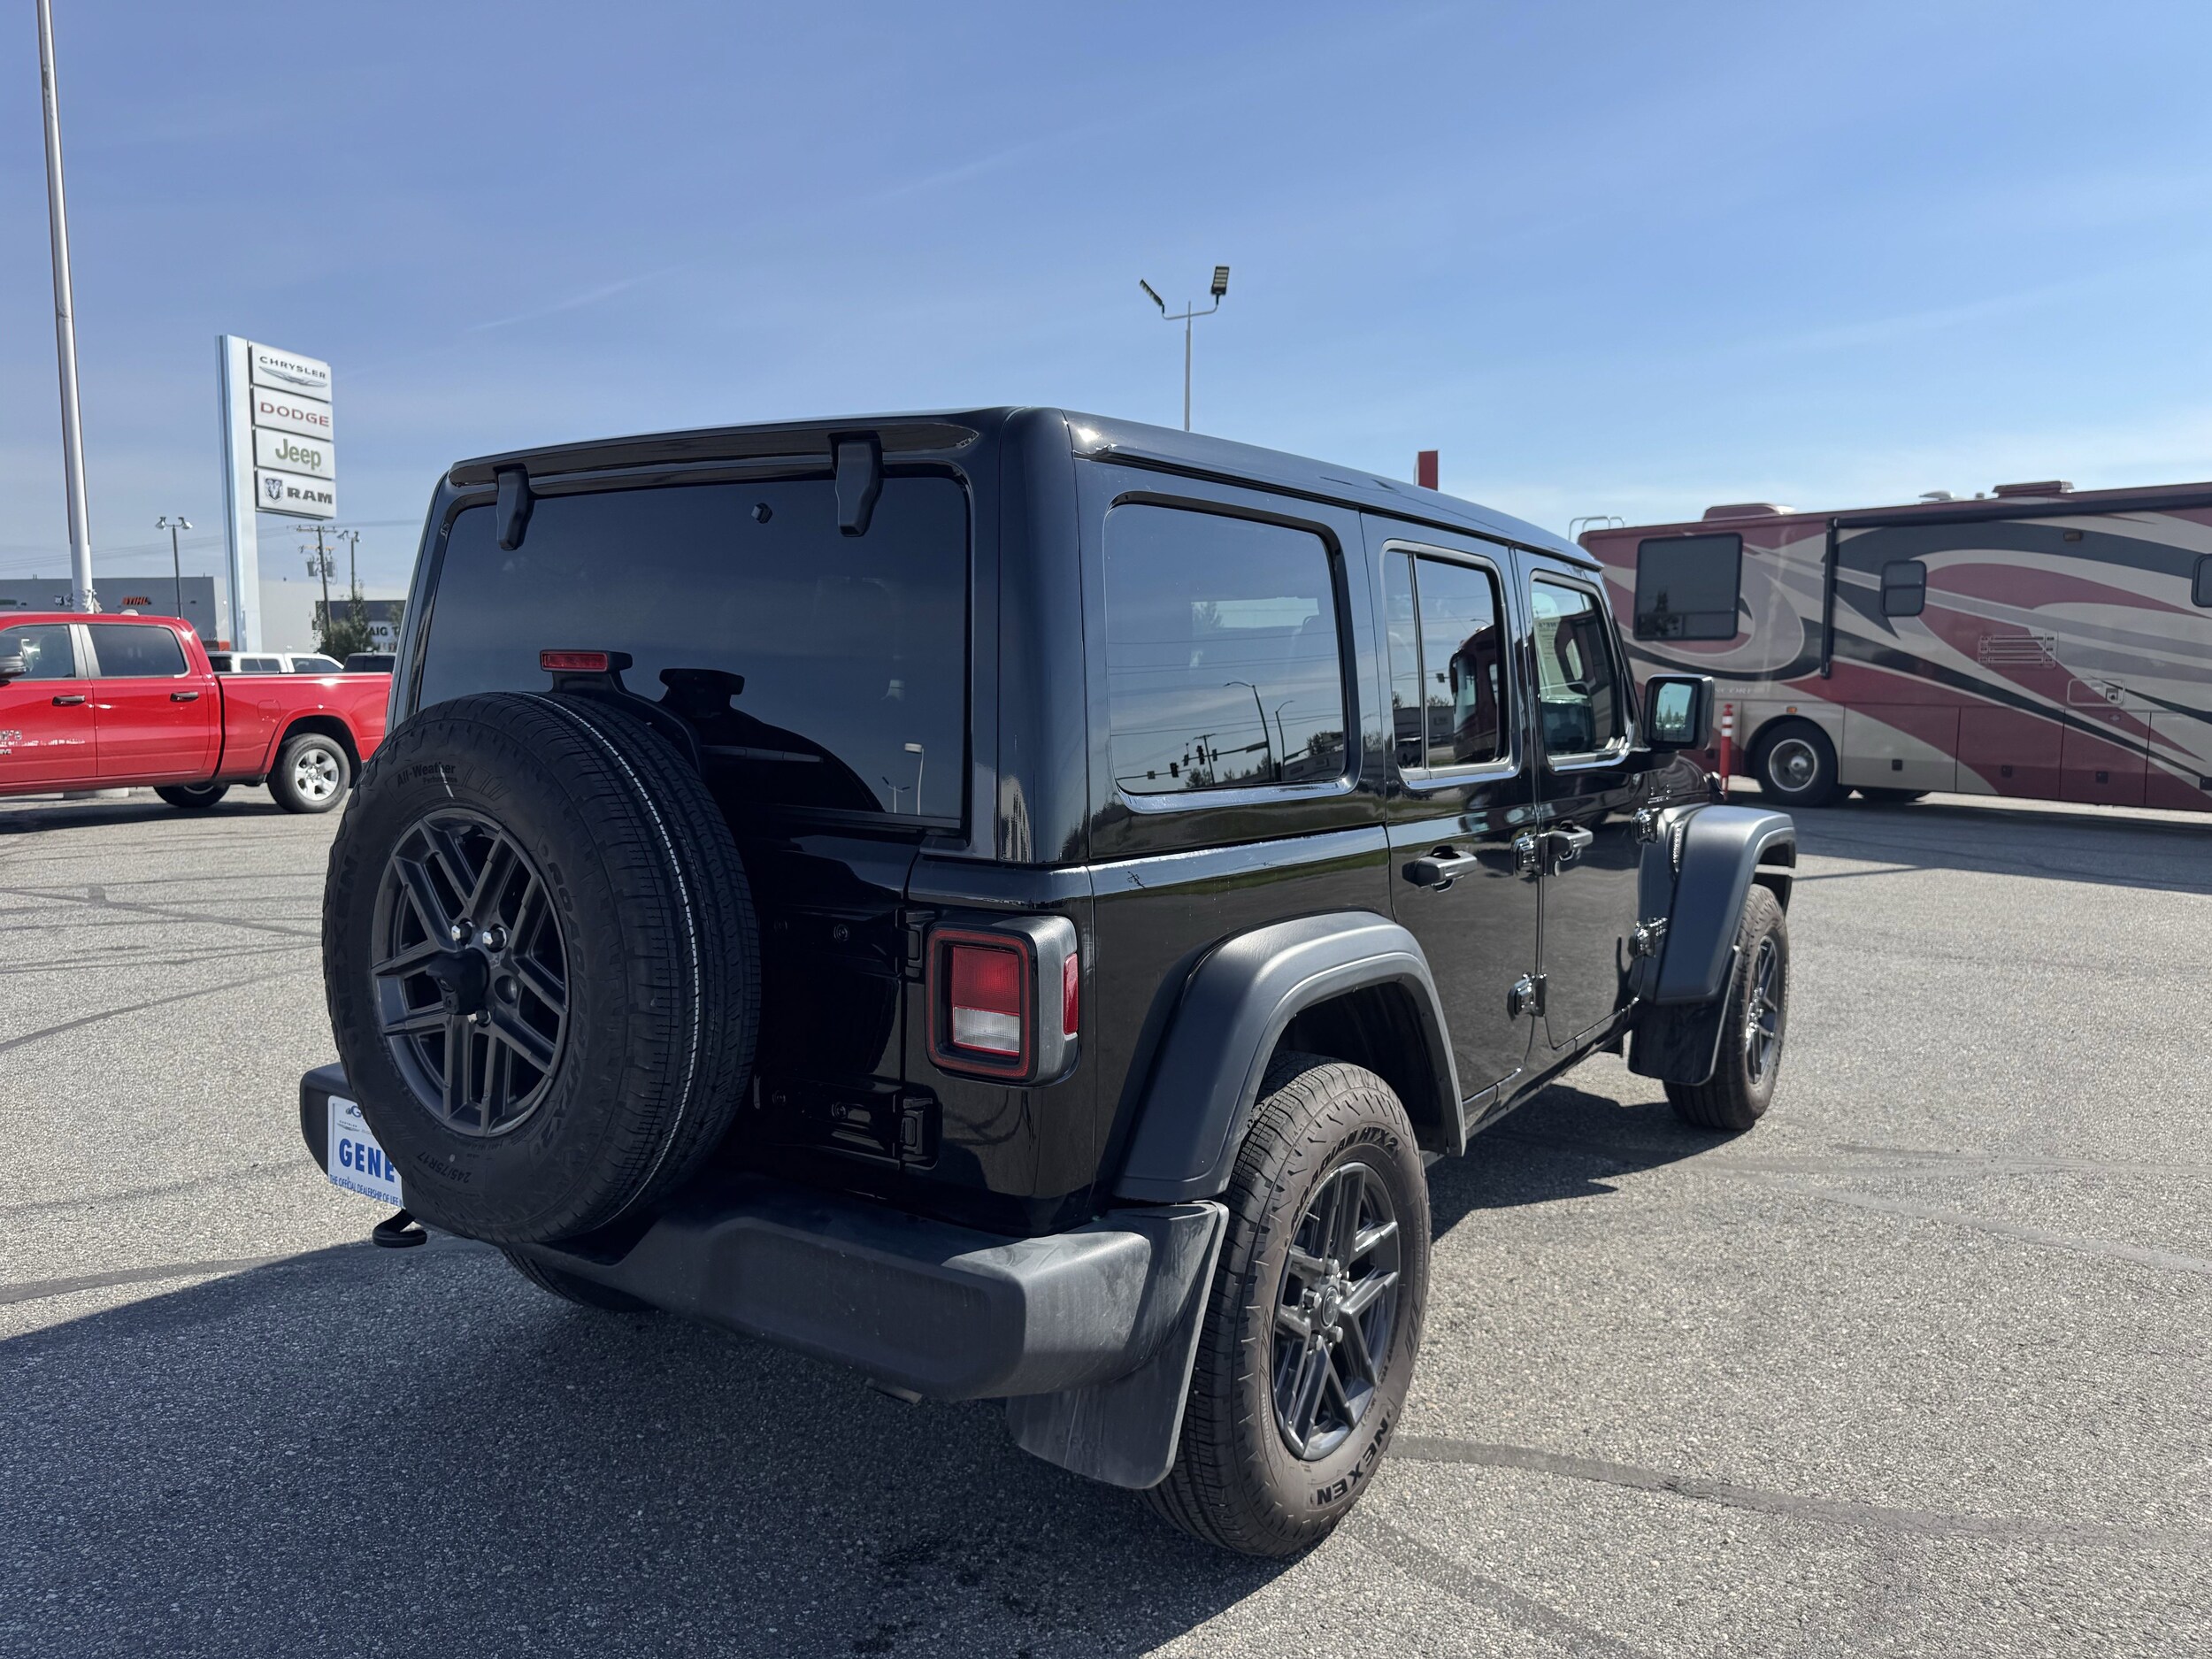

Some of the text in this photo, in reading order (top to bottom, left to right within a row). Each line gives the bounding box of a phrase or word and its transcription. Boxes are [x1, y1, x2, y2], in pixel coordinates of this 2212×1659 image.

[259, 356, 326, 380] CHRYSLER
[260, 402, 330, 427] DODGE
[275, 439, 322, 471] Jeep
[287, 487, 333, 504] RAM
[122, 596, 150, 605] STIHL
[397, 761, 457, 787] All-Weather
[423, 776, 457, 785] Performnce
[334, 855, 358, 1029] NEXEN
[416, 1151, 472, 1185] 245/75R17
[1290, 1127, 1358, 1235] ROADIAN
[339, 1178, 356, 1192] OFFICIAL
[357, 1184, 382, 1201] DEALERSHIP
[382, 1193, 389, 1202] OF
[390, 1195, 399, 1206] LIFE
[1317, 1416, 1388, 1506] NEXEN
